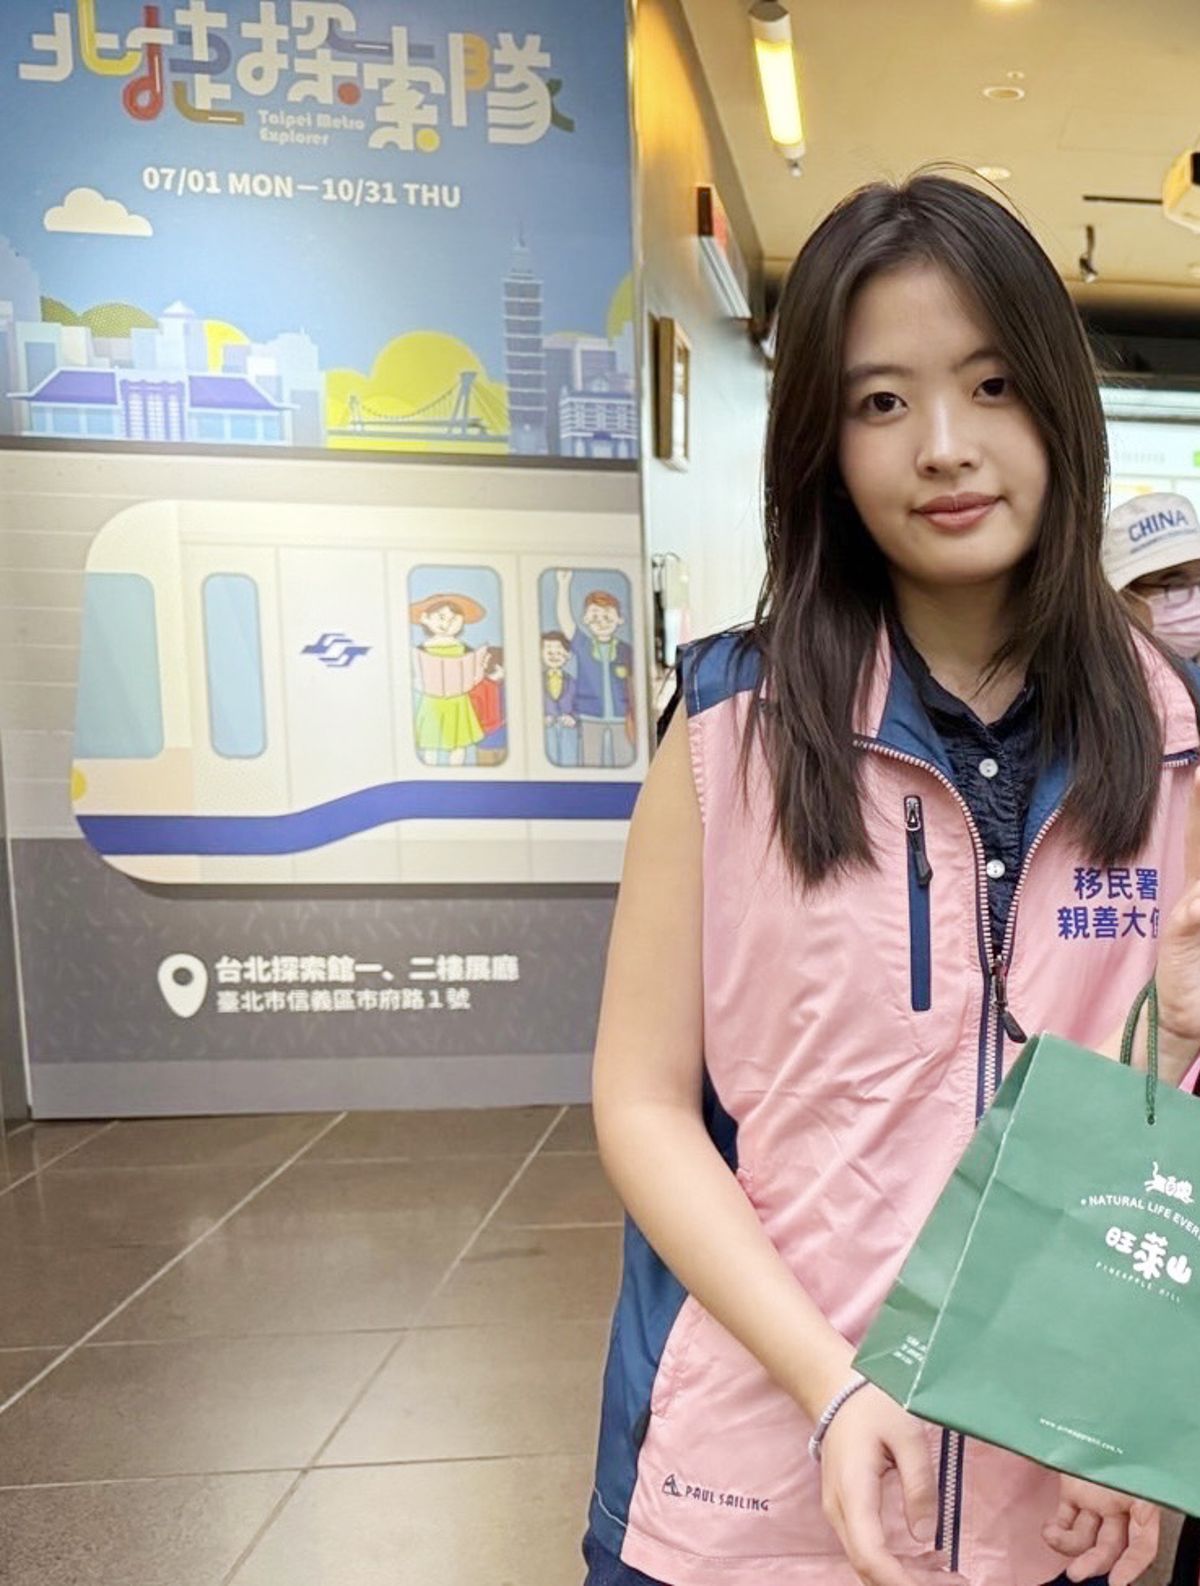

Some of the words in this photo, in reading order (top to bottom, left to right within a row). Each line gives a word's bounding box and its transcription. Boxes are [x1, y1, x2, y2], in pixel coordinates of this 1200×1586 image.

[19, 0, 574, 151] 北捷探索隊
[258, 109, 311, 129] Taipei
[316, 113, 365, 130] Metro
[259, 127, 329, 145] Explorer
[142, 167, 221, 196] 07/01
[403, 182, 461, 208] THU
[1128, 509, 1190, 543] CHINA
[1073, 866, 1160, 901] 移民署
[1088, 1194, 1145, 1210] NATURAL
[1147, 1202, 1171, 1219] LIFE
[1096, 1261, 1153, 1290] PINEAPPLE
[685, 1485, 716, 1504] PAUL
[719, 1493, 770, 1512] SAILING
